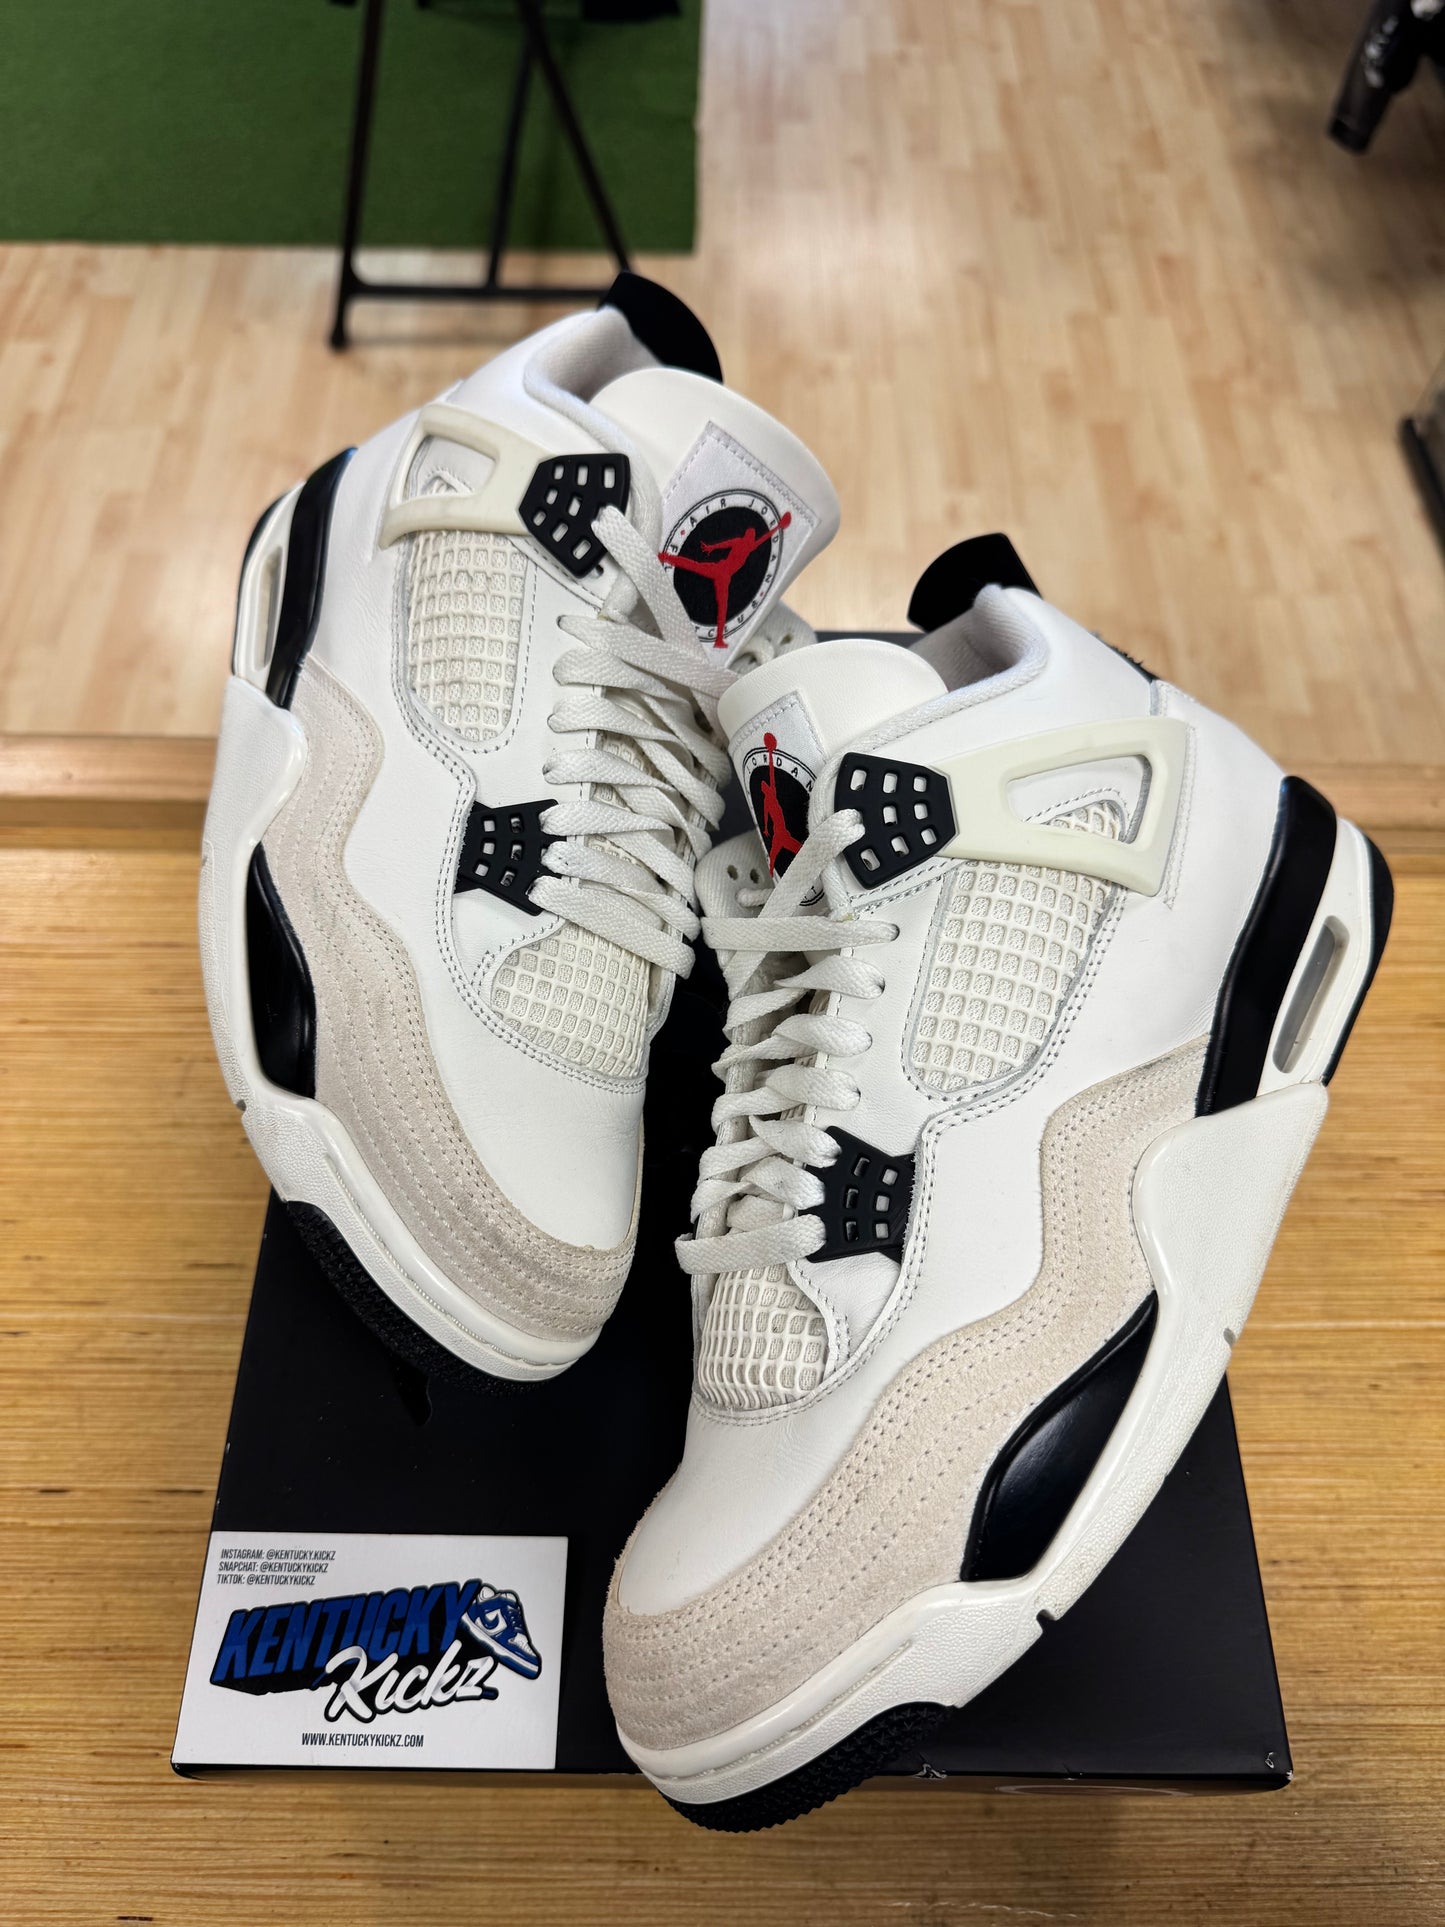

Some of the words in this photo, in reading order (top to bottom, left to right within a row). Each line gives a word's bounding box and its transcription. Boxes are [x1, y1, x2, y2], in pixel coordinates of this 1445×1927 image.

[689, 498, 726, 528] AIR
[748, 498, 780, 584] JORDAN
[746, 753, 814, 793] JORDAN
[218, 1561, 259, 1572] SNAPCHAT:
[260, 1561, 329, 1574] @KENTUCKYKICKZ
[220, 1548, 265, 1560] INSTAGRAM:
[266, 1548, 337, 1561] @KENTUCKY.KICKZ
[216, 1573, 246, 1585] TIKTOK:
[246, 1573, 316, 1586] @KENTUCKYKICKZ
[211, 1579, 483, 1687] KENTUCKY
[325, 1638, 496, 1721] Kickz
[301, 1732, 425, 1748] WWW.KENTUCKYKICKZ.COM
